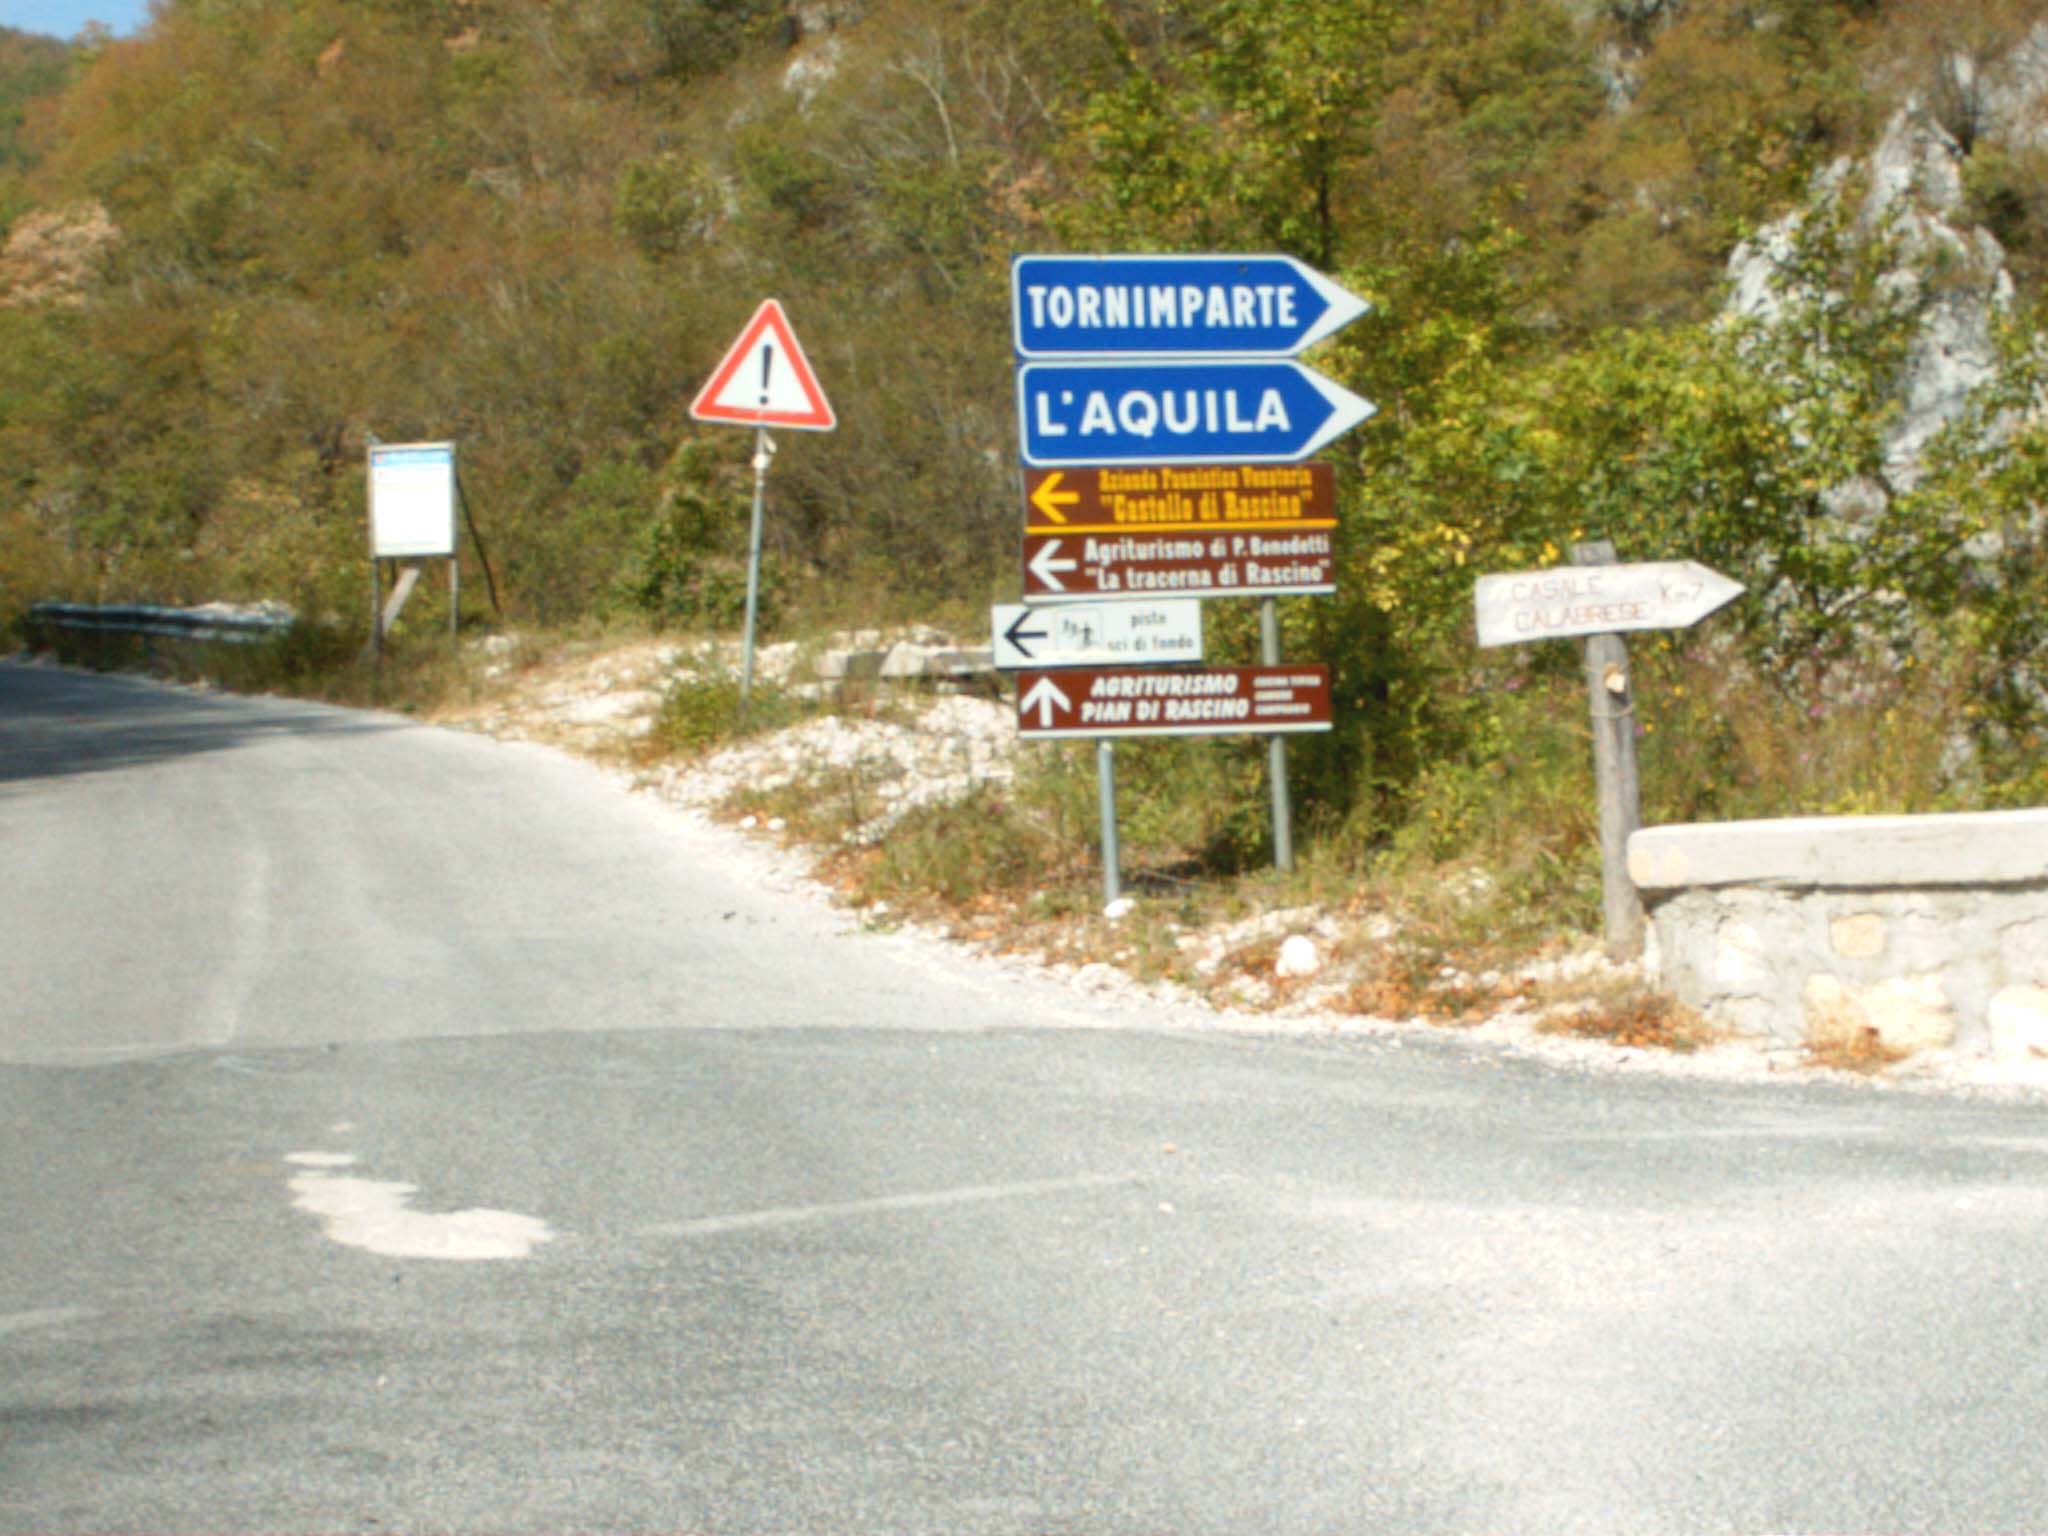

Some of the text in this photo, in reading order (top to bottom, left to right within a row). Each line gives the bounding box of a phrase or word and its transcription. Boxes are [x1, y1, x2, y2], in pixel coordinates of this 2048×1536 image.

[1027, 285, 1297, 328] TORNIMPARTE
[1036, 388, 1291, 437] L'AQUILA
[1199, 492, 1218, 520] di
[1084, 537, 1205, 566] Agriturismo
[1209, 538, 1226, 558] di
[1218, 562, 1238, 585] di
[1134, 636, 1147, 651] di
[1091, 673, 1239, 697] AGRITURISMO
[1081, 701, 1132, 722] PIAN
[1135, 699, 1161, 721] DI
[1164, 697, 1250, 721] RASCINO
